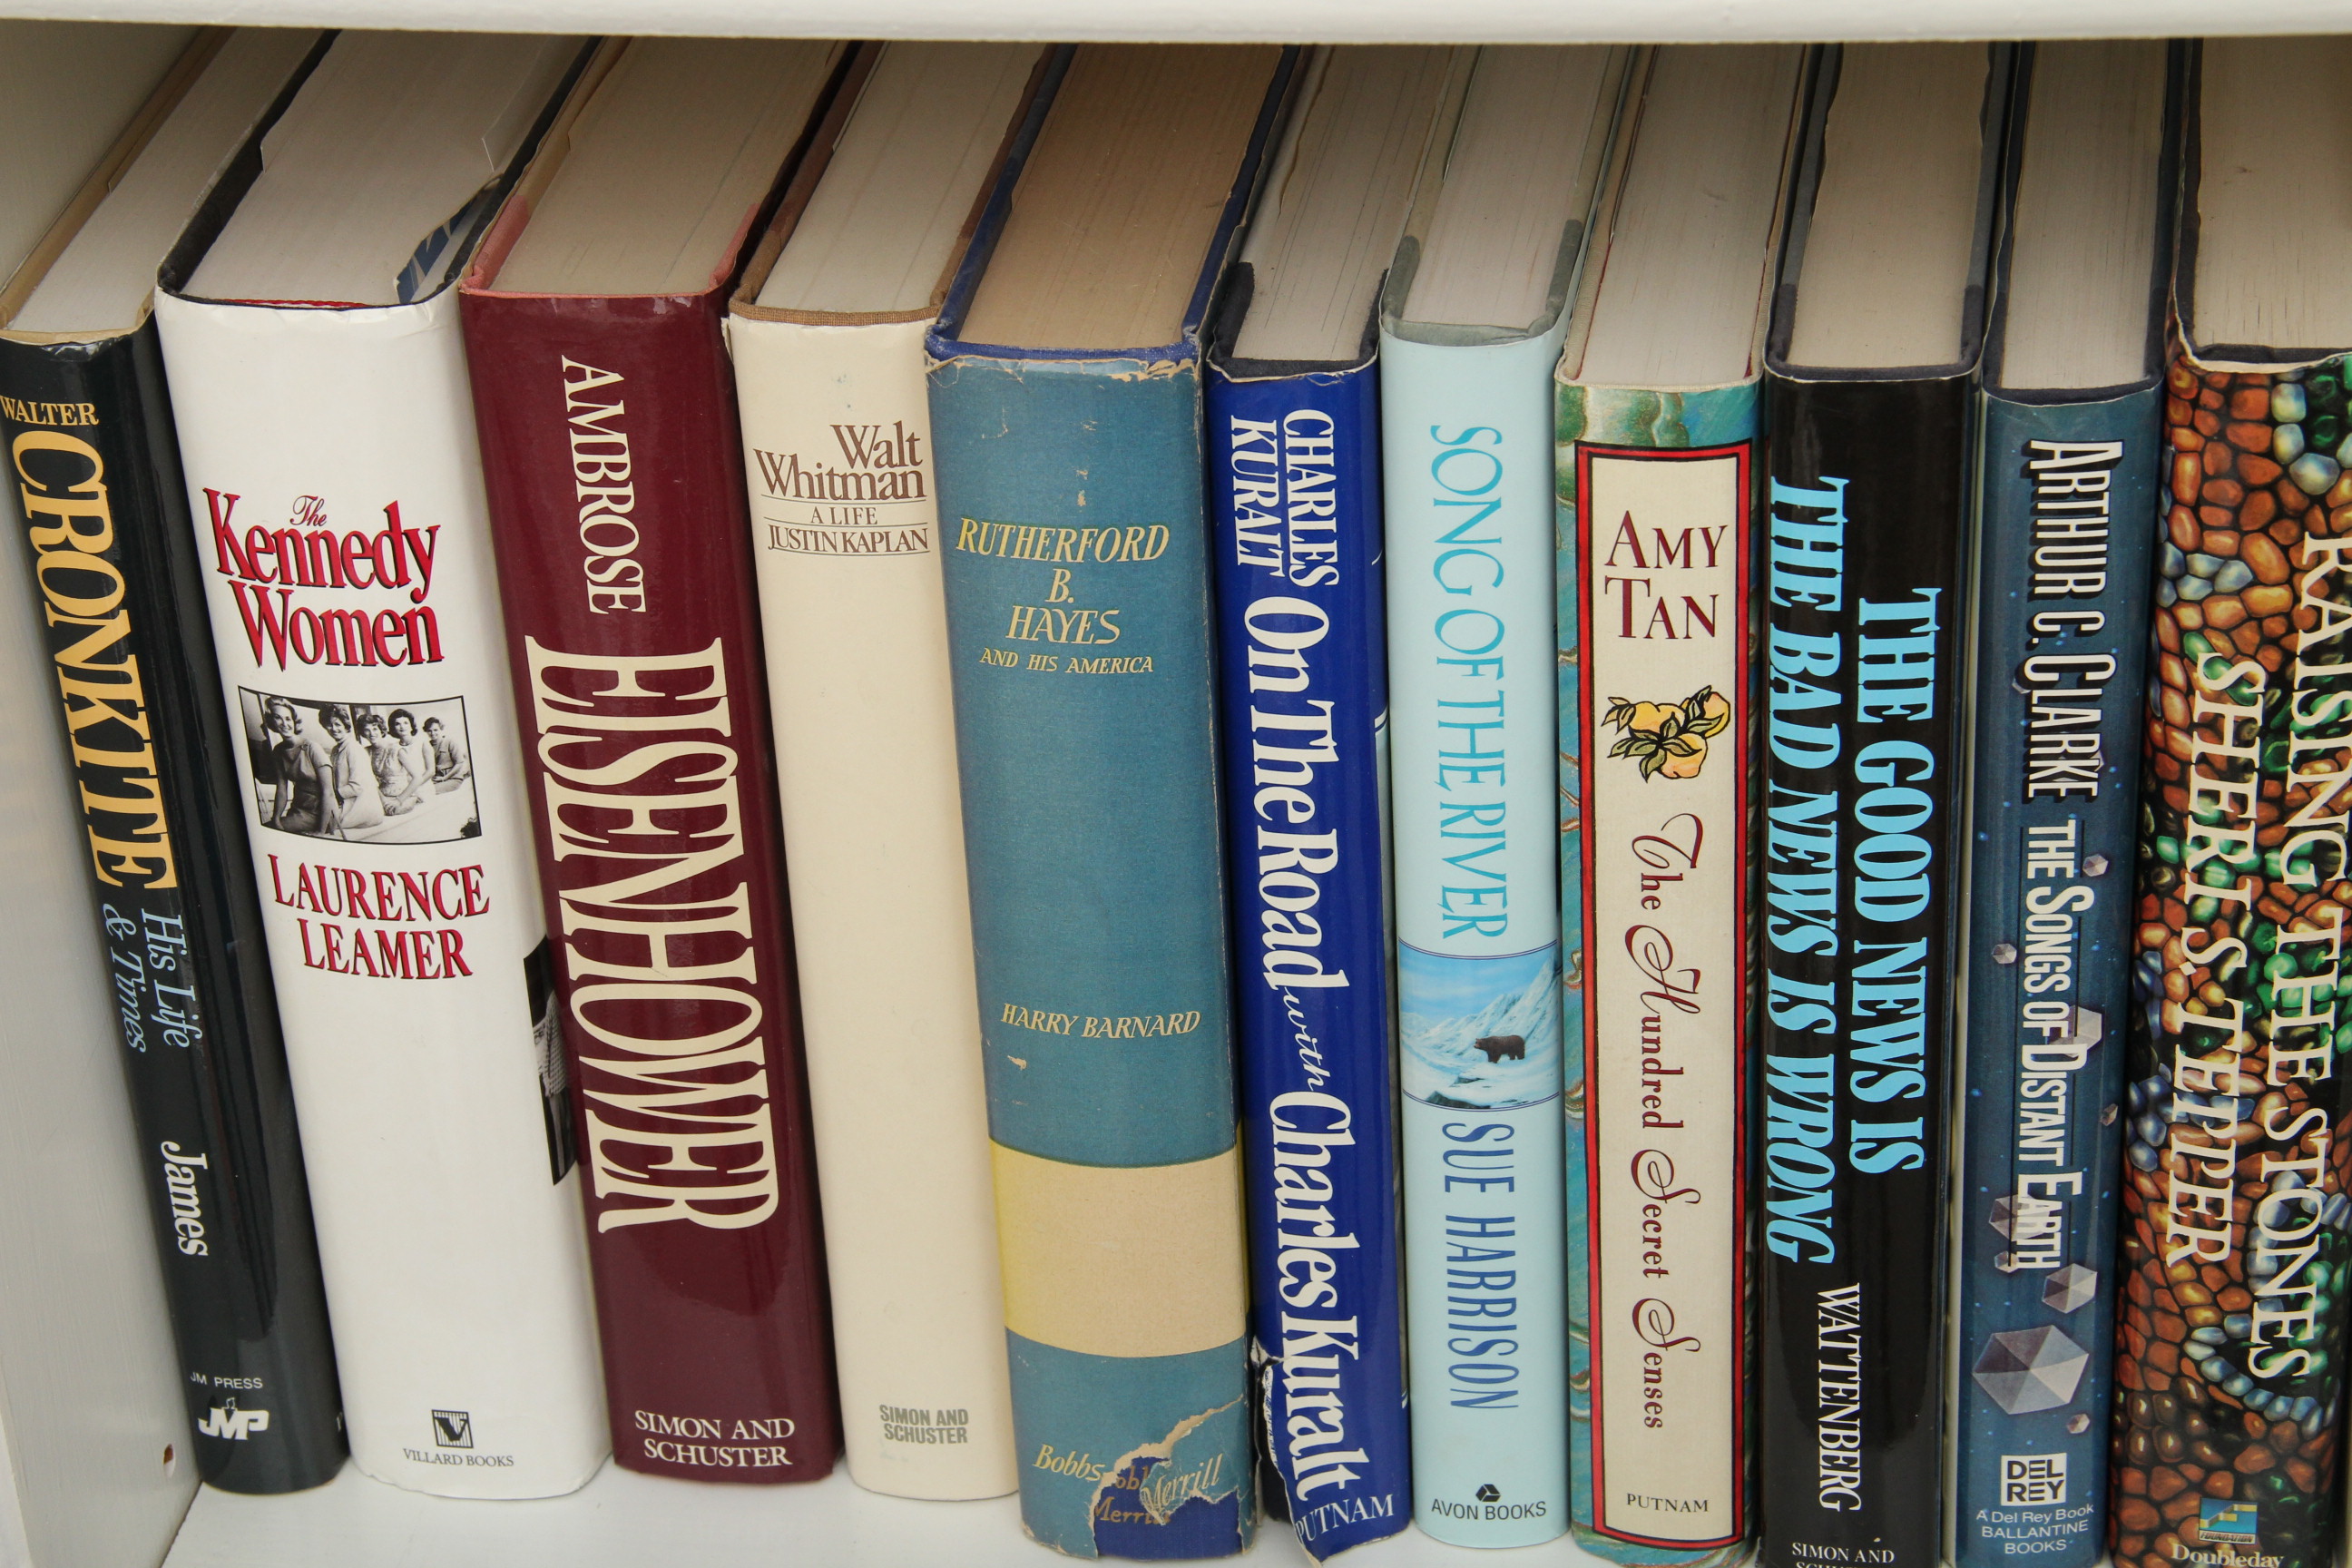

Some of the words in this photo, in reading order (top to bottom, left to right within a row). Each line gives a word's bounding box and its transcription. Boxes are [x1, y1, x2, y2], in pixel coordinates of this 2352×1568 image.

[0, 395, 100, 426] WALTER
[829, 420, 923, 468] Walt
[561, 355, 646, 615] AMBROSE
[752, 447, 926, 500] Whitman
[1230, 415, 1286, 577] KURALT
[1283, 409, 1340, 589] CHARLES
[202, 486, 441, 602] Kennedy
[289, 495, 327, 527] The
[768, 524, 840, 553] JUSTIN
[840, 528, 929, 554] KAPLAN
[809, 507, 825, 524] A
[829, 507, 878, 525] LIFE
[956, 517, 1170, 563] RUTHERFORD
[1429, 424, 1505, 596] SONG
[1604, 509, 1728, 569] AMY
[1769, 475, 1850, 612] THE
[2027, 439, 2123, 602] ARTHUR
[1044, 568, 1075, 605] B.
[1604, 576, 1720, 641] TAN
[12, 430, 178, 889] CRONKITE
[228, 579, 444, 671] Women
[1004, 606, 1122, 646] HAYES
[1244, 596, 1329, 694] On
[1434, 609, 1505, 682] OF
[1857, 588, 1942, 724] THE
[2030, 609, 2106, 646] C.
[979, 648, 1019, 669] AND
[1026, 653, 1059, 672] HIS
[1065, 655, 1154, 675] AMERICA
[1767, 622, 1841, 770] BAD
[1436, 689, 1505, 791] THE
[2023, 652, 2118, 799] CLARKE
[2279, 531, 2352, 887] RAISING
[1250, 698, 1340, 822] The
[2183, 652, 2268, 911] SHERI
[1632, 813, 1703, 911] The
[1854, 740, 1935, 923] GOOD
[2026, 819, 2077, 879] THE
[267, 853, 489, 922] LAURENCE
[1439, 801, 1508, 940] RIVER
[1767, 779, 1840, 957] NEWS
[103, 903, 137, 942] &
[142, 908, 187, 972] His
[524, 635, 779, 1234] EISENHOWER
[1256, 824, 1350, 990] Road
[2023, 885, 2095, 995] SONGS
[296, 918, 473, 980] LEAMER
[2179, 926, 2249, 975] S.
[111, 946, 146, 1053] Times
[151, 979, 203, 1048] Life
[1000, 1003, 1079, 1035] HARRY
[1082, 1010, 1201, 1039] BARNARD
[1624, 924, 1701, 1130] Hundred
[1767, 967, 1837, 1037] IS
[1851, 936, 1927, 1102] NEWS
[2036, 1001, 2070, 1039] OF
[2267, 907, 2342, 1087] THE
[1284, 987, 1327, 1093] with
[2017, 1044, 2088, 1167] DISTANT
[2166, 997, 2245, 1268] TEPPER
[1442, 1122, 1515, 1193] SUE
[1766, 1053, 1838, 1264] WRONG
[1849, 1116, 1925, 1175] IS
[161, 1142, 209, 1257] James
[1269, 1090, 1361, 1309] Charles
[1631, 1149, 1700, 1279] Secret
[2014, 1171, 2082, 1270] EARTH
[2248, 1106, 2329, 1380] STONES
[1446, 1215, 1519, 1409] HARRISON
[191, 1372, 207, 1385] JM
[214, 1377, 263, 1389] PRESS
[1631, 1298, 1700, 1430] Senses
[1816, 1283, 1863, 1513] WATTENBERG
[198, 1407, 269, 1440] JMP
[634, 1410, 722, 1439] SIMON
[730, 1418, 795, 1440] AND
[878, 1404, 932, 1426] SIMON
[936, 1407, 969, 1427] AND
[883, 1422, 968, 1446] SCHUSTER
[1281, 1310, 1370, 1501] Kuralt
[403, 1448, 463, 1465] VILLARD
[466, 1455, 514, 1467] BOOKS
[643, 1437, 793, 1467] SCHUSTER
[1140, 1453, 1223, 1514] Merrill
[2007, 1459, 2063, 1479] DEL
[1295, 1494, 1394, 1543] PUTNAM
[1431, 1498, 1479, 1520] AVON
[1485, 1501, 1546, 1520] BOOKS
[1626, 1492, 1710, 1514] PUTNAM
[1976, 1510, 1988, 1522] A
[1992, 1512, 2017, 1523] Del
[2023, 1512, 2053, 1524] Rey
[2055, 1504, 2094, 1520] Book
[2007, 1480, 2064, 1502] REY
[1791, 1542, 1849, 1561] SIMON
[1855, 1549, 1895, 1563] AND
[1982, 1520, 2089, 1539] BALLANTINE
[2004, 1539, 2067, 1554] BOOKS
[2171, 1543, 2284, 1568] Doubleday
